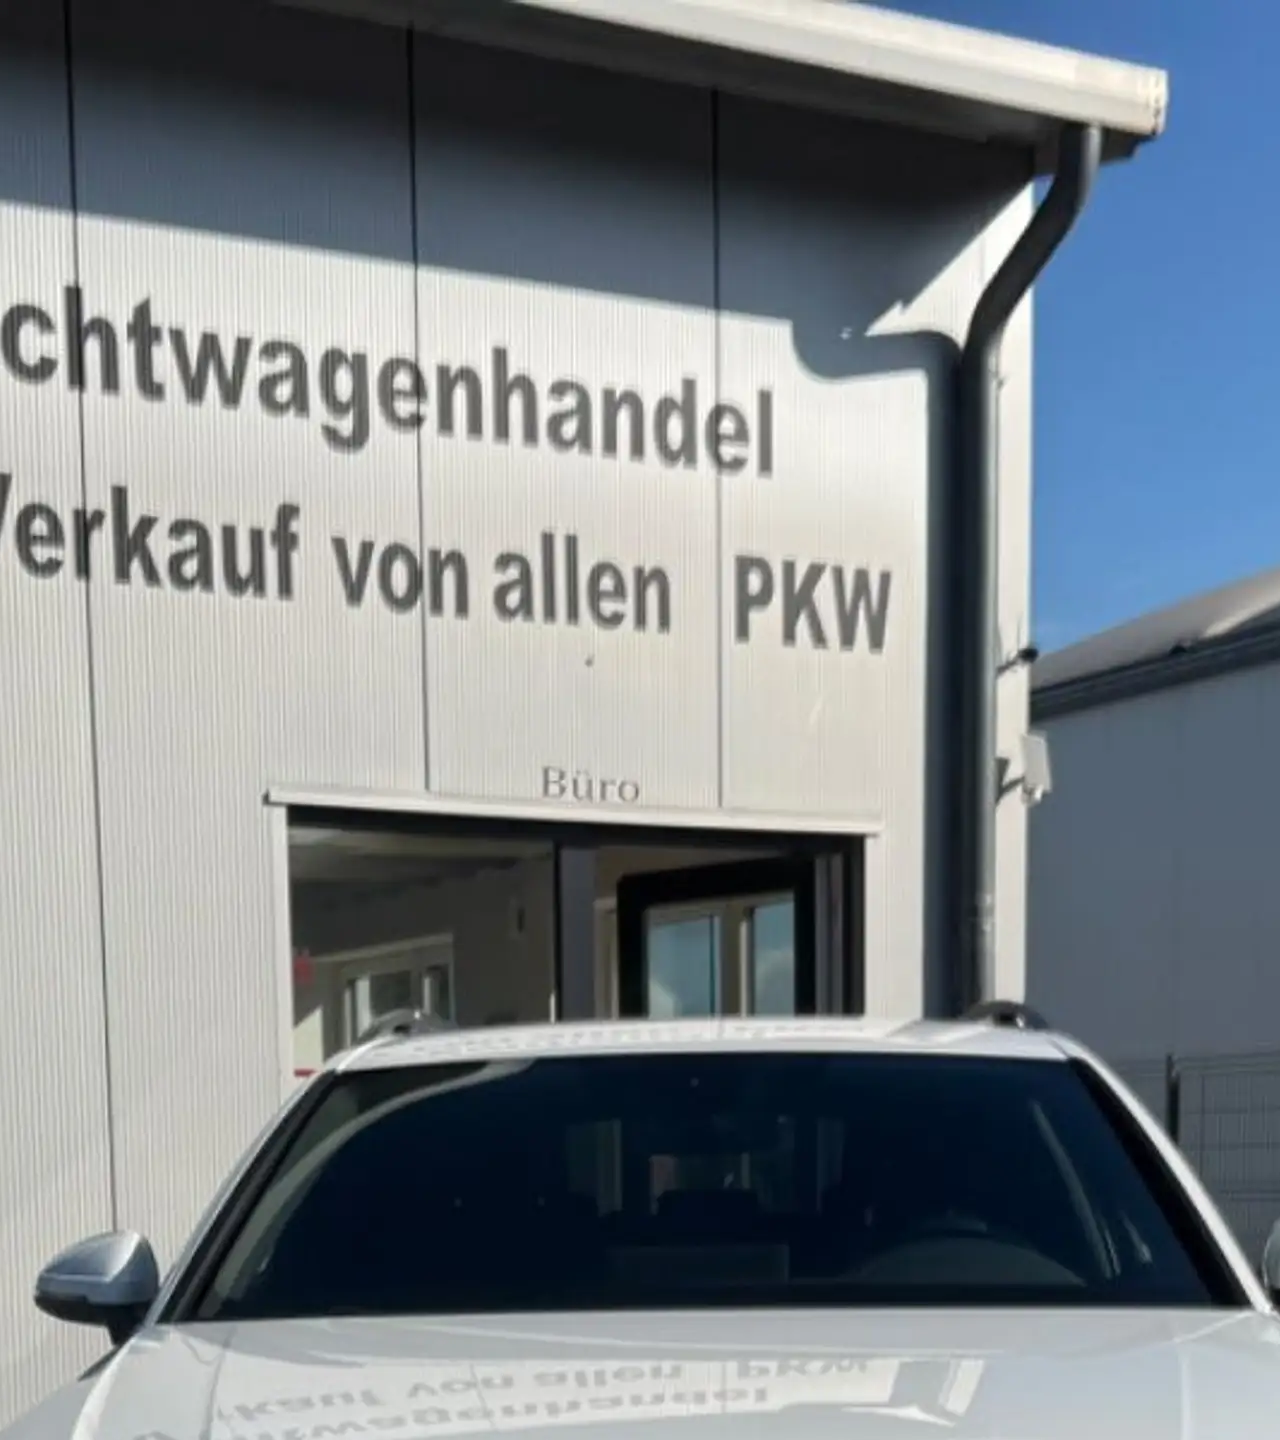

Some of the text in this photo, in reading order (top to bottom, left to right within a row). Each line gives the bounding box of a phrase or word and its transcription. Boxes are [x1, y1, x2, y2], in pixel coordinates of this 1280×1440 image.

[331, 535, 470, 621] von
[492, 530, 672, 634] allen
[734, 553, 892, 655] PKW
[542, 765, 640, 804] Büro
